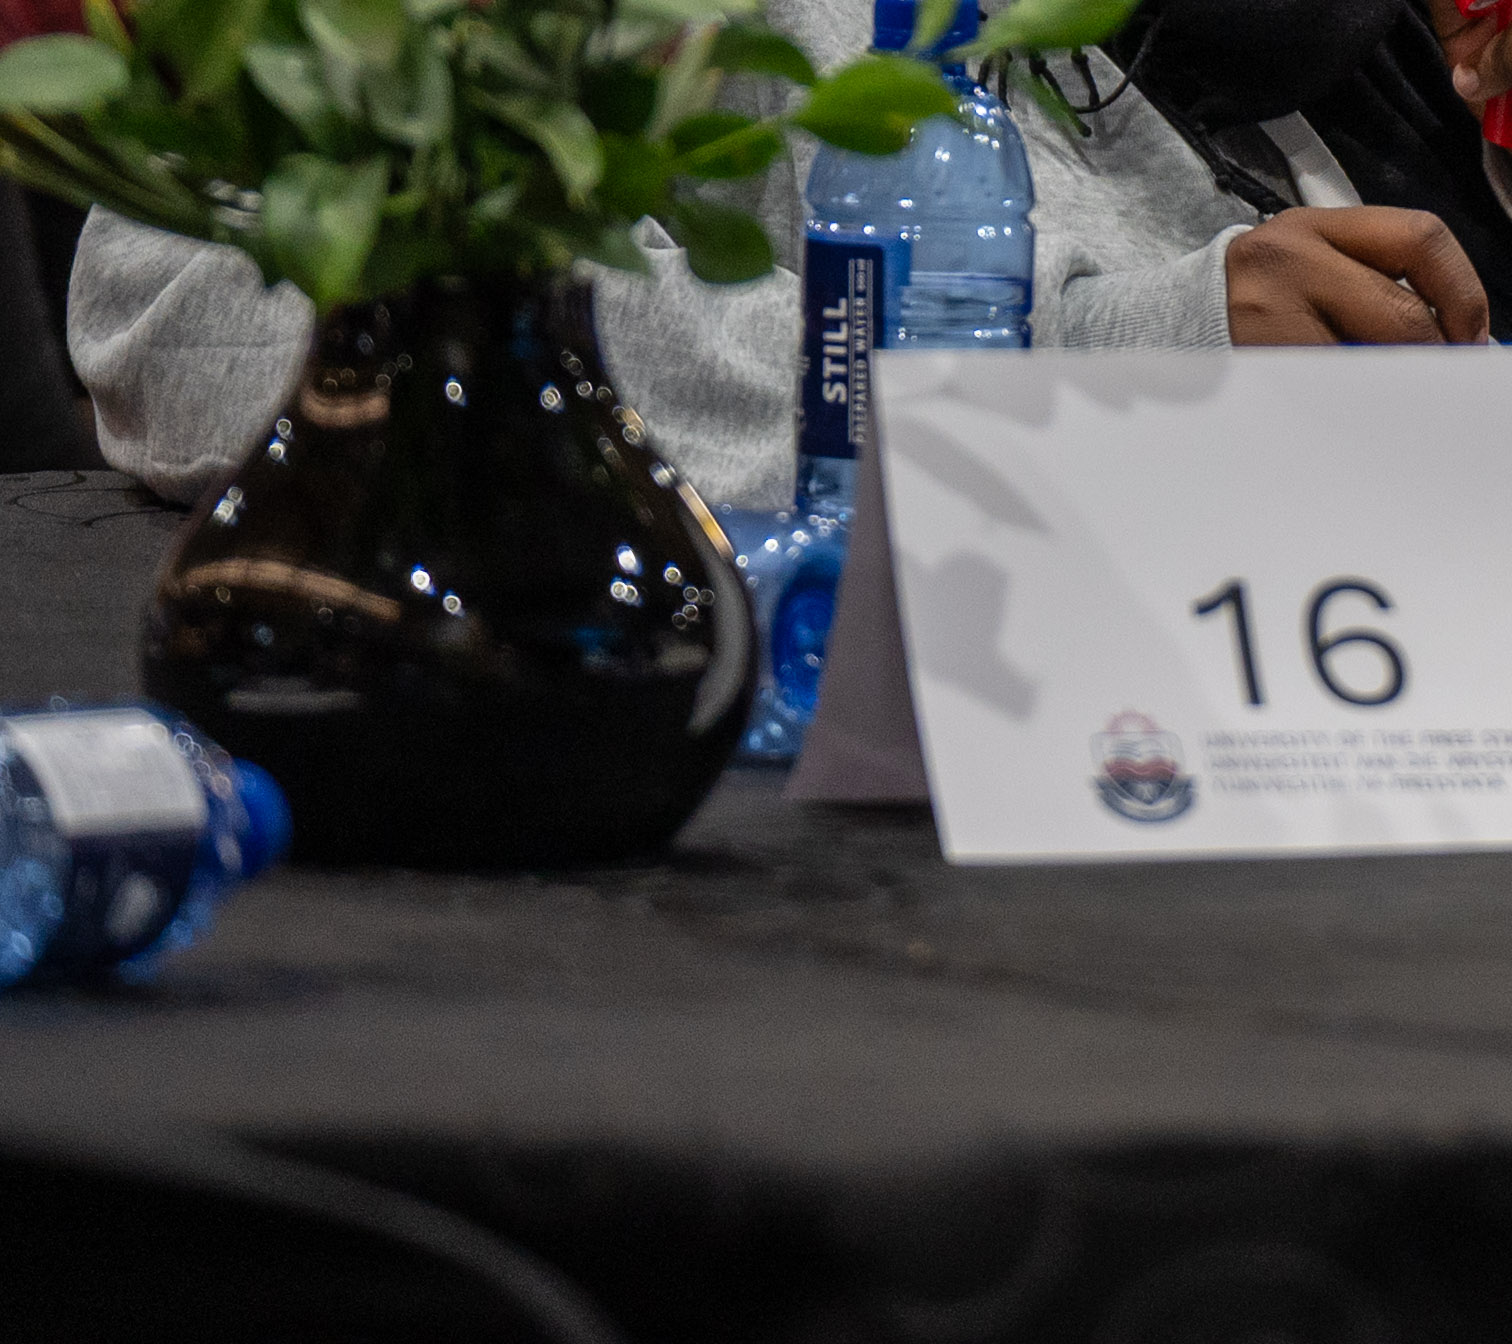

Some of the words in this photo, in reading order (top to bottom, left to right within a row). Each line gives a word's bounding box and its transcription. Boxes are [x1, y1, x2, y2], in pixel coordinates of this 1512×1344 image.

[822, 297, 848, 404] STILL
[854, 297, 868, 352] WATER
[1191, 574, 1411, 709] 16
